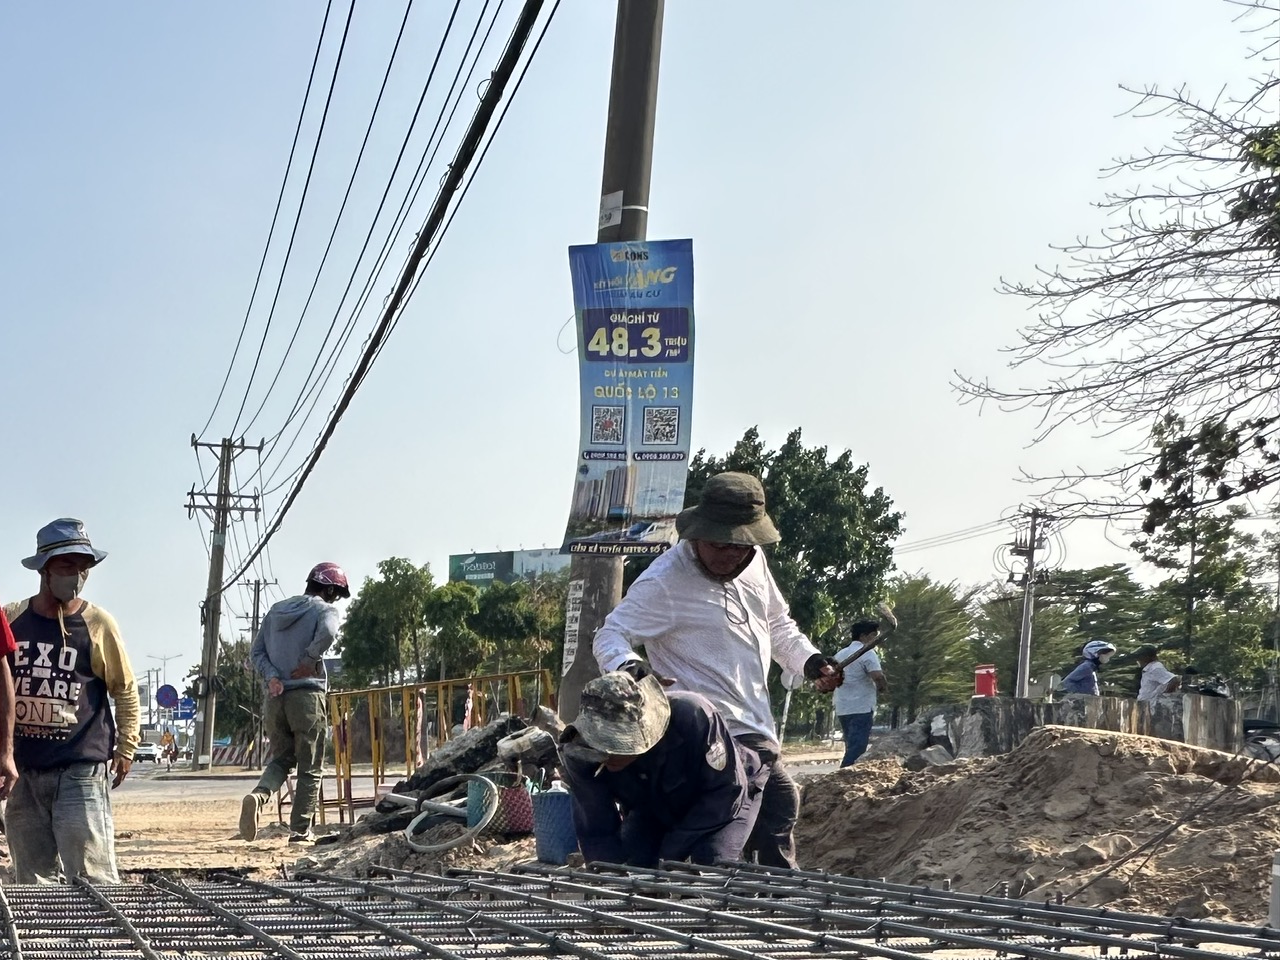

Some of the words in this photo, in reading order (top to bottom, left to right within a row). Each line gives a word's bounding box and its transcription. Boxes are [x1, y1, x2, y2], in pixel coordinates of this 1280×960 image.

[587, 327, 662, 358] 48.3
[662, 386, 680, 400] 13
[14, 641, 78, 672] EXO
[35, 678, 82, 701] ARE
[15, 700, 65, 724] ONE
